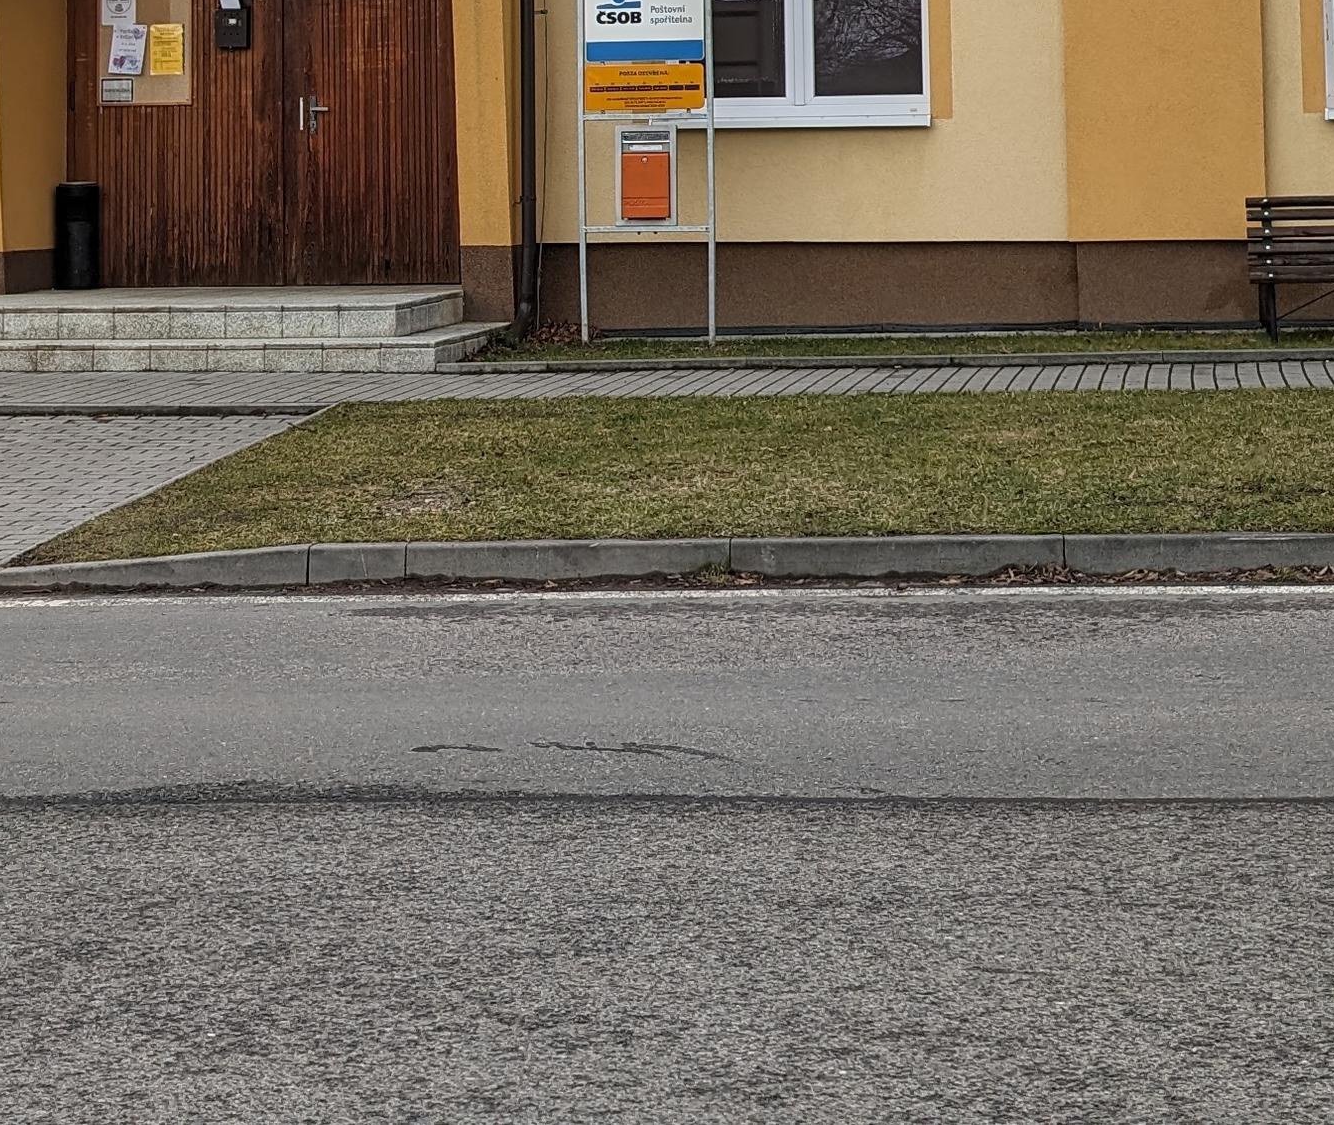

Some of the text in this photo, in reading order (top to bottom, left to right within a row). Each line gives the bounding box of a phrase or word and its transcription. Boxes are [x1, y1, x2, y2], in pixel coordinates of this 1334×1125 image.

[650, 4, 686, 14] Poštovní
[596, 10, 642, 25] ČSOB
[649, 15, 693, 26] spořitelna
